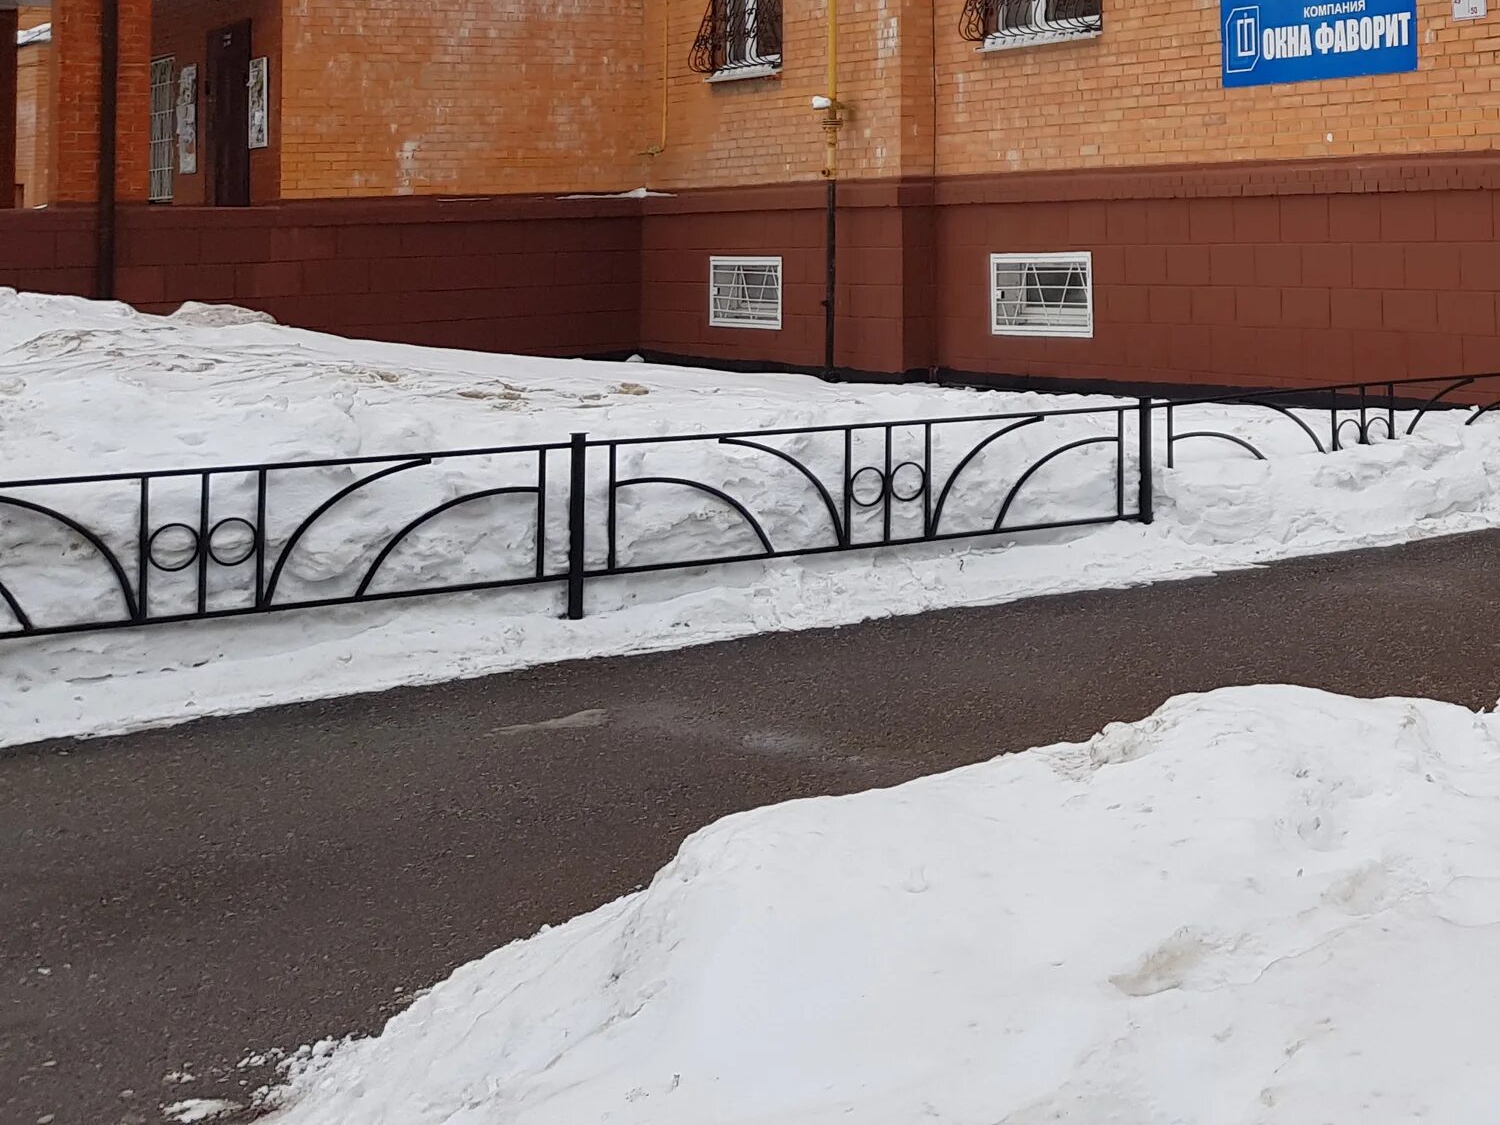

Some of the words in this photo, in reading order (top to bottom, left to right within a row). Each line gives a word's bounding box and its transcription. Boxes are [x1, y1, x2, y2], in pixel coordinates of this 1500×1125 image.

[1303, 0, 1366, 18] КОМПАНИЯ
[1262, 24, 1312, 61] ОКНА
[1315, 12, 1412, 55] ФАВОРИТ
